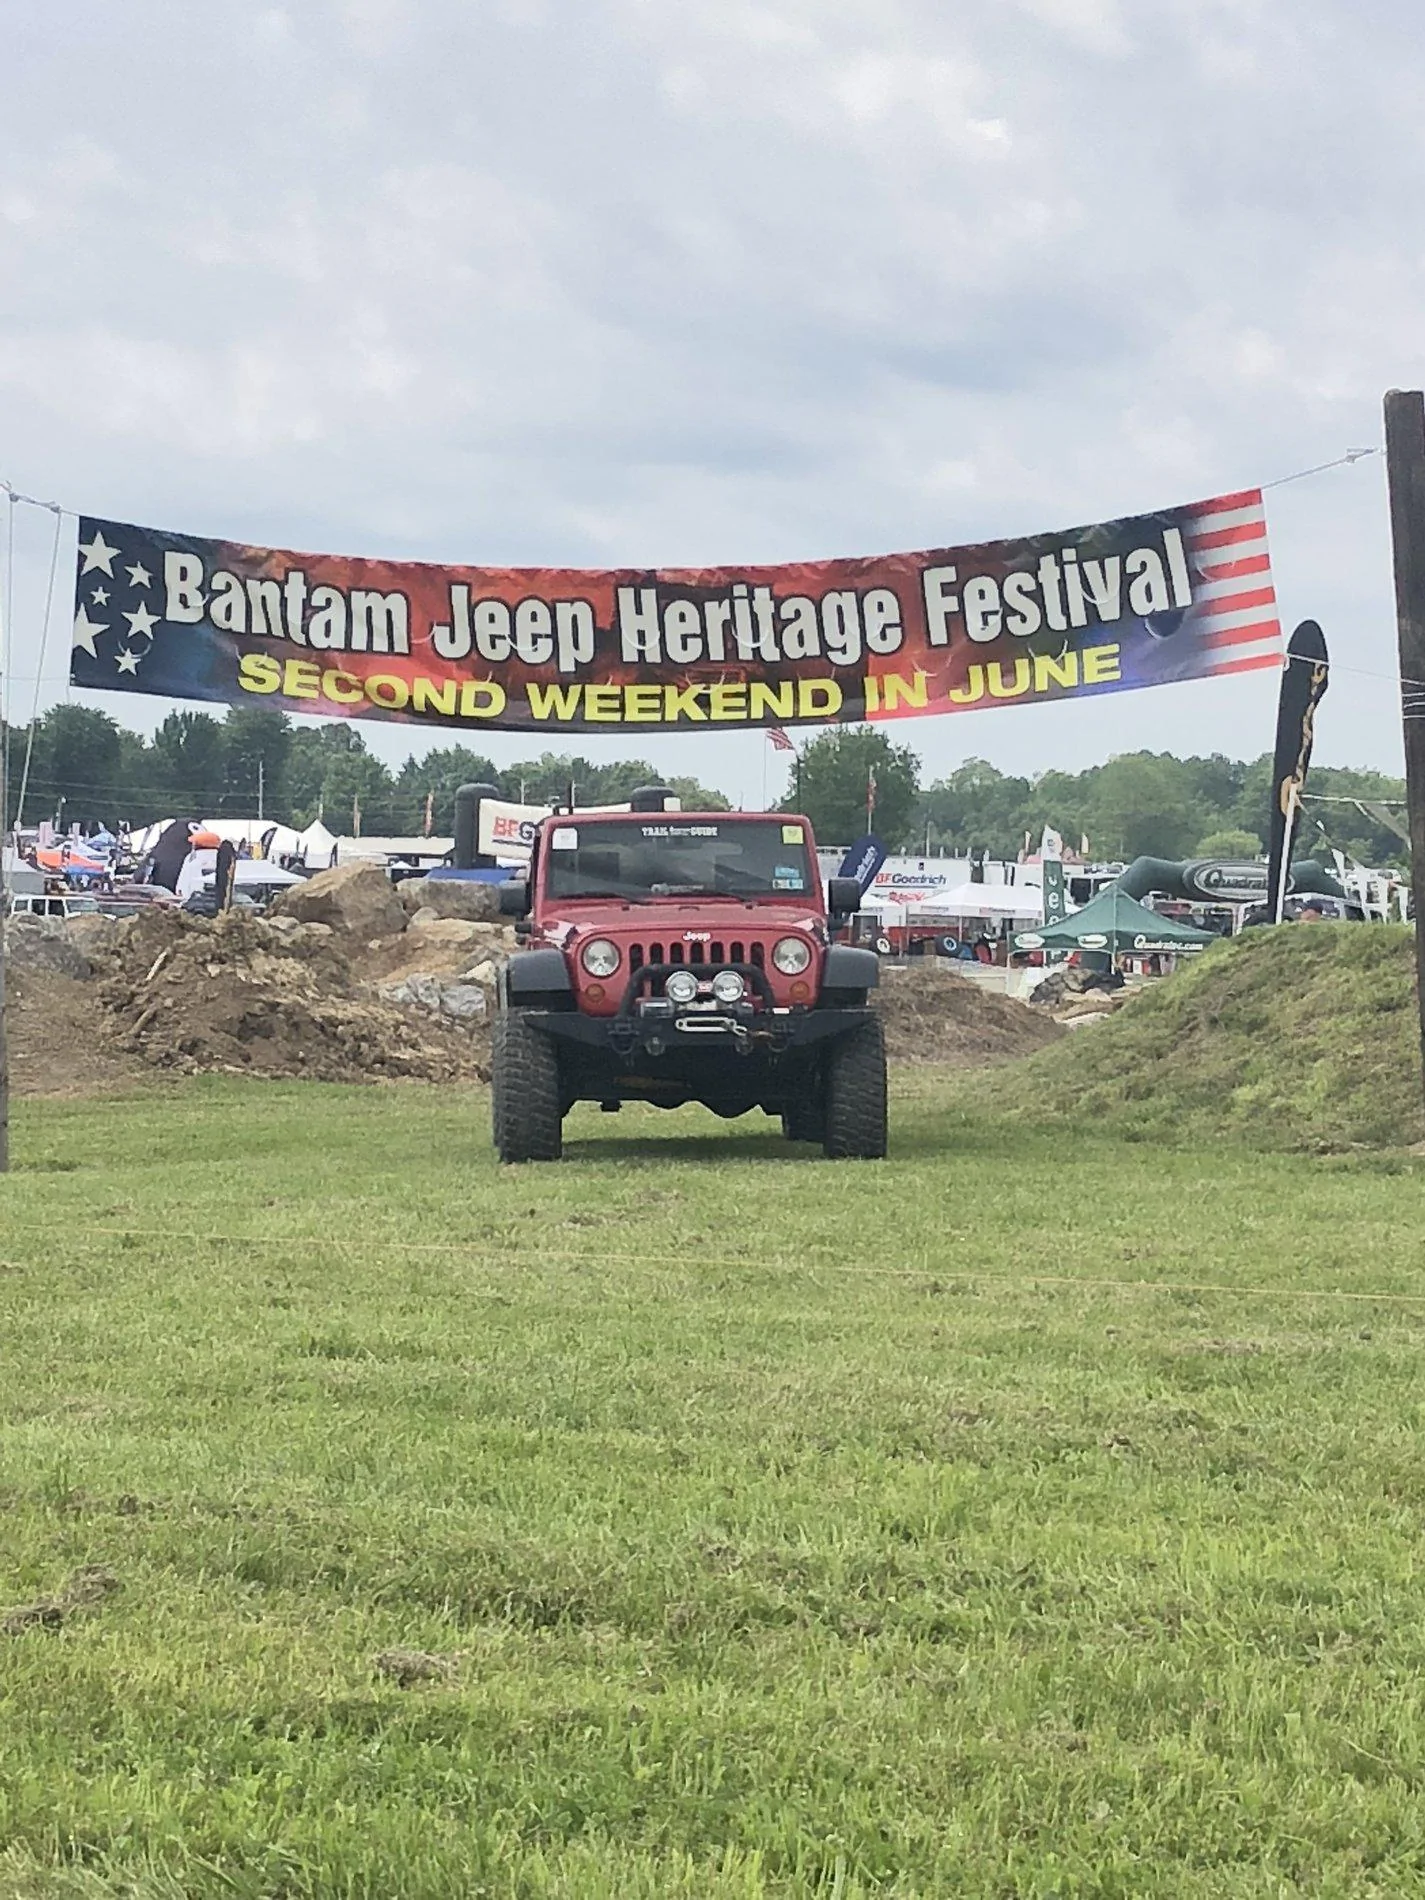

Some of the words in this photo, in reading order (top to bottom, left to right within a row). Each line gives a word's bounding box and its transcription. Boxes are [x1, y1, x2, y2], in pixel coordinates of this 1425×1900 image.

[164, 551, 409, 653] Bantam
[434, 585, 595, 672] Jeep
[618, 584, 902, 665] Heritage
[923, 528, 1193, 645] Festival
[239, 654, 506, 717] SECOND
[526, 678, 842, 722] WEEKEND
[864, 671, 929, 713] IN
[950, 644, 1122, 704] JUNE
[876, 872, 946, 885] BFGoodrich
[682, 931, 711, 942] Jeep
